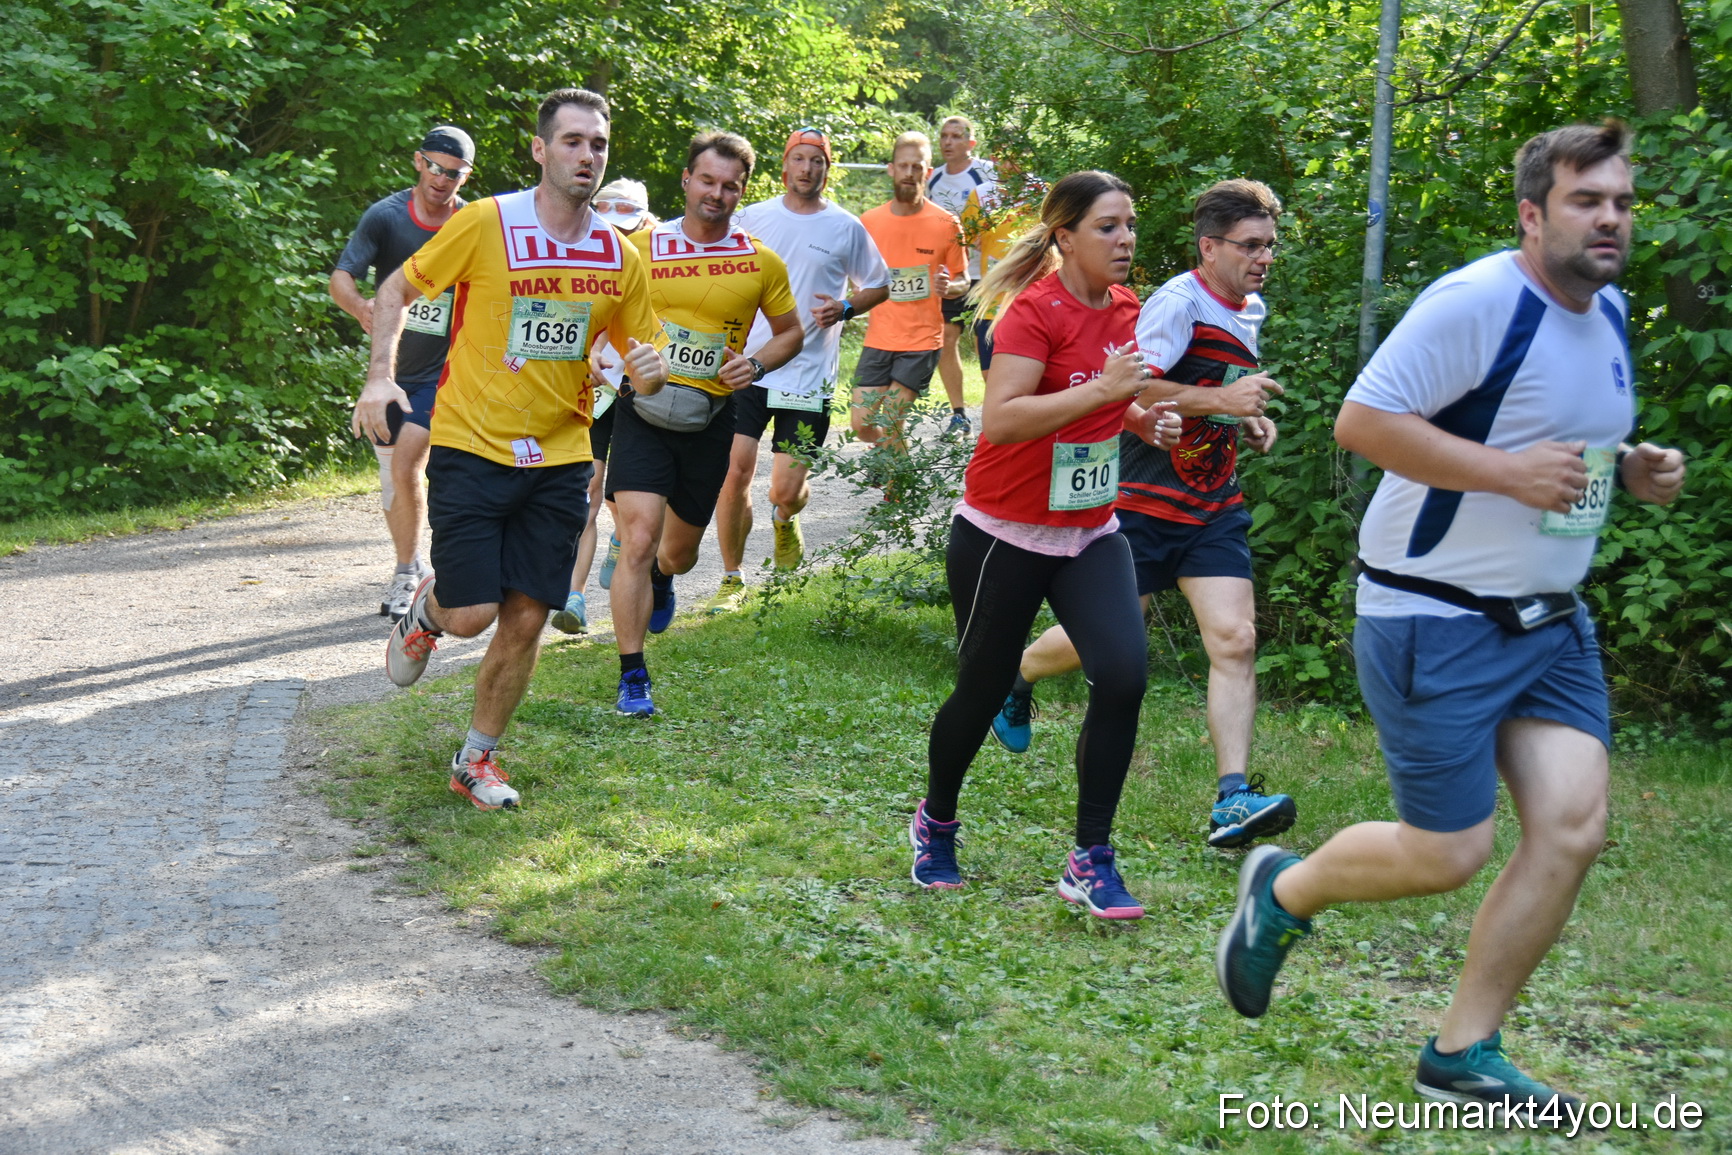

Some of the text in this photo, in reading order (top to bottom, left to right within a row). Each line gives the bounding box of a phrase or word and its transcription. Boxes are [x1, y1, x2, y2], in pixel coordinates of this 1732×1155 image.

[651, 260, 760, 280] MAX BÖGL
[509, 273, 622, 297] MAX BÖGL
[891, 277, 925, 292] 2312
[408, 303, 441, 323] 482
[521, 320, 579, 344] 1636
[522, 342, 559, 351] Moosburger
[668, 343, 716, 367] 1606
[1071, 463, 1110, 492] 610
[1069, 491, 1092, 499] Schiller
